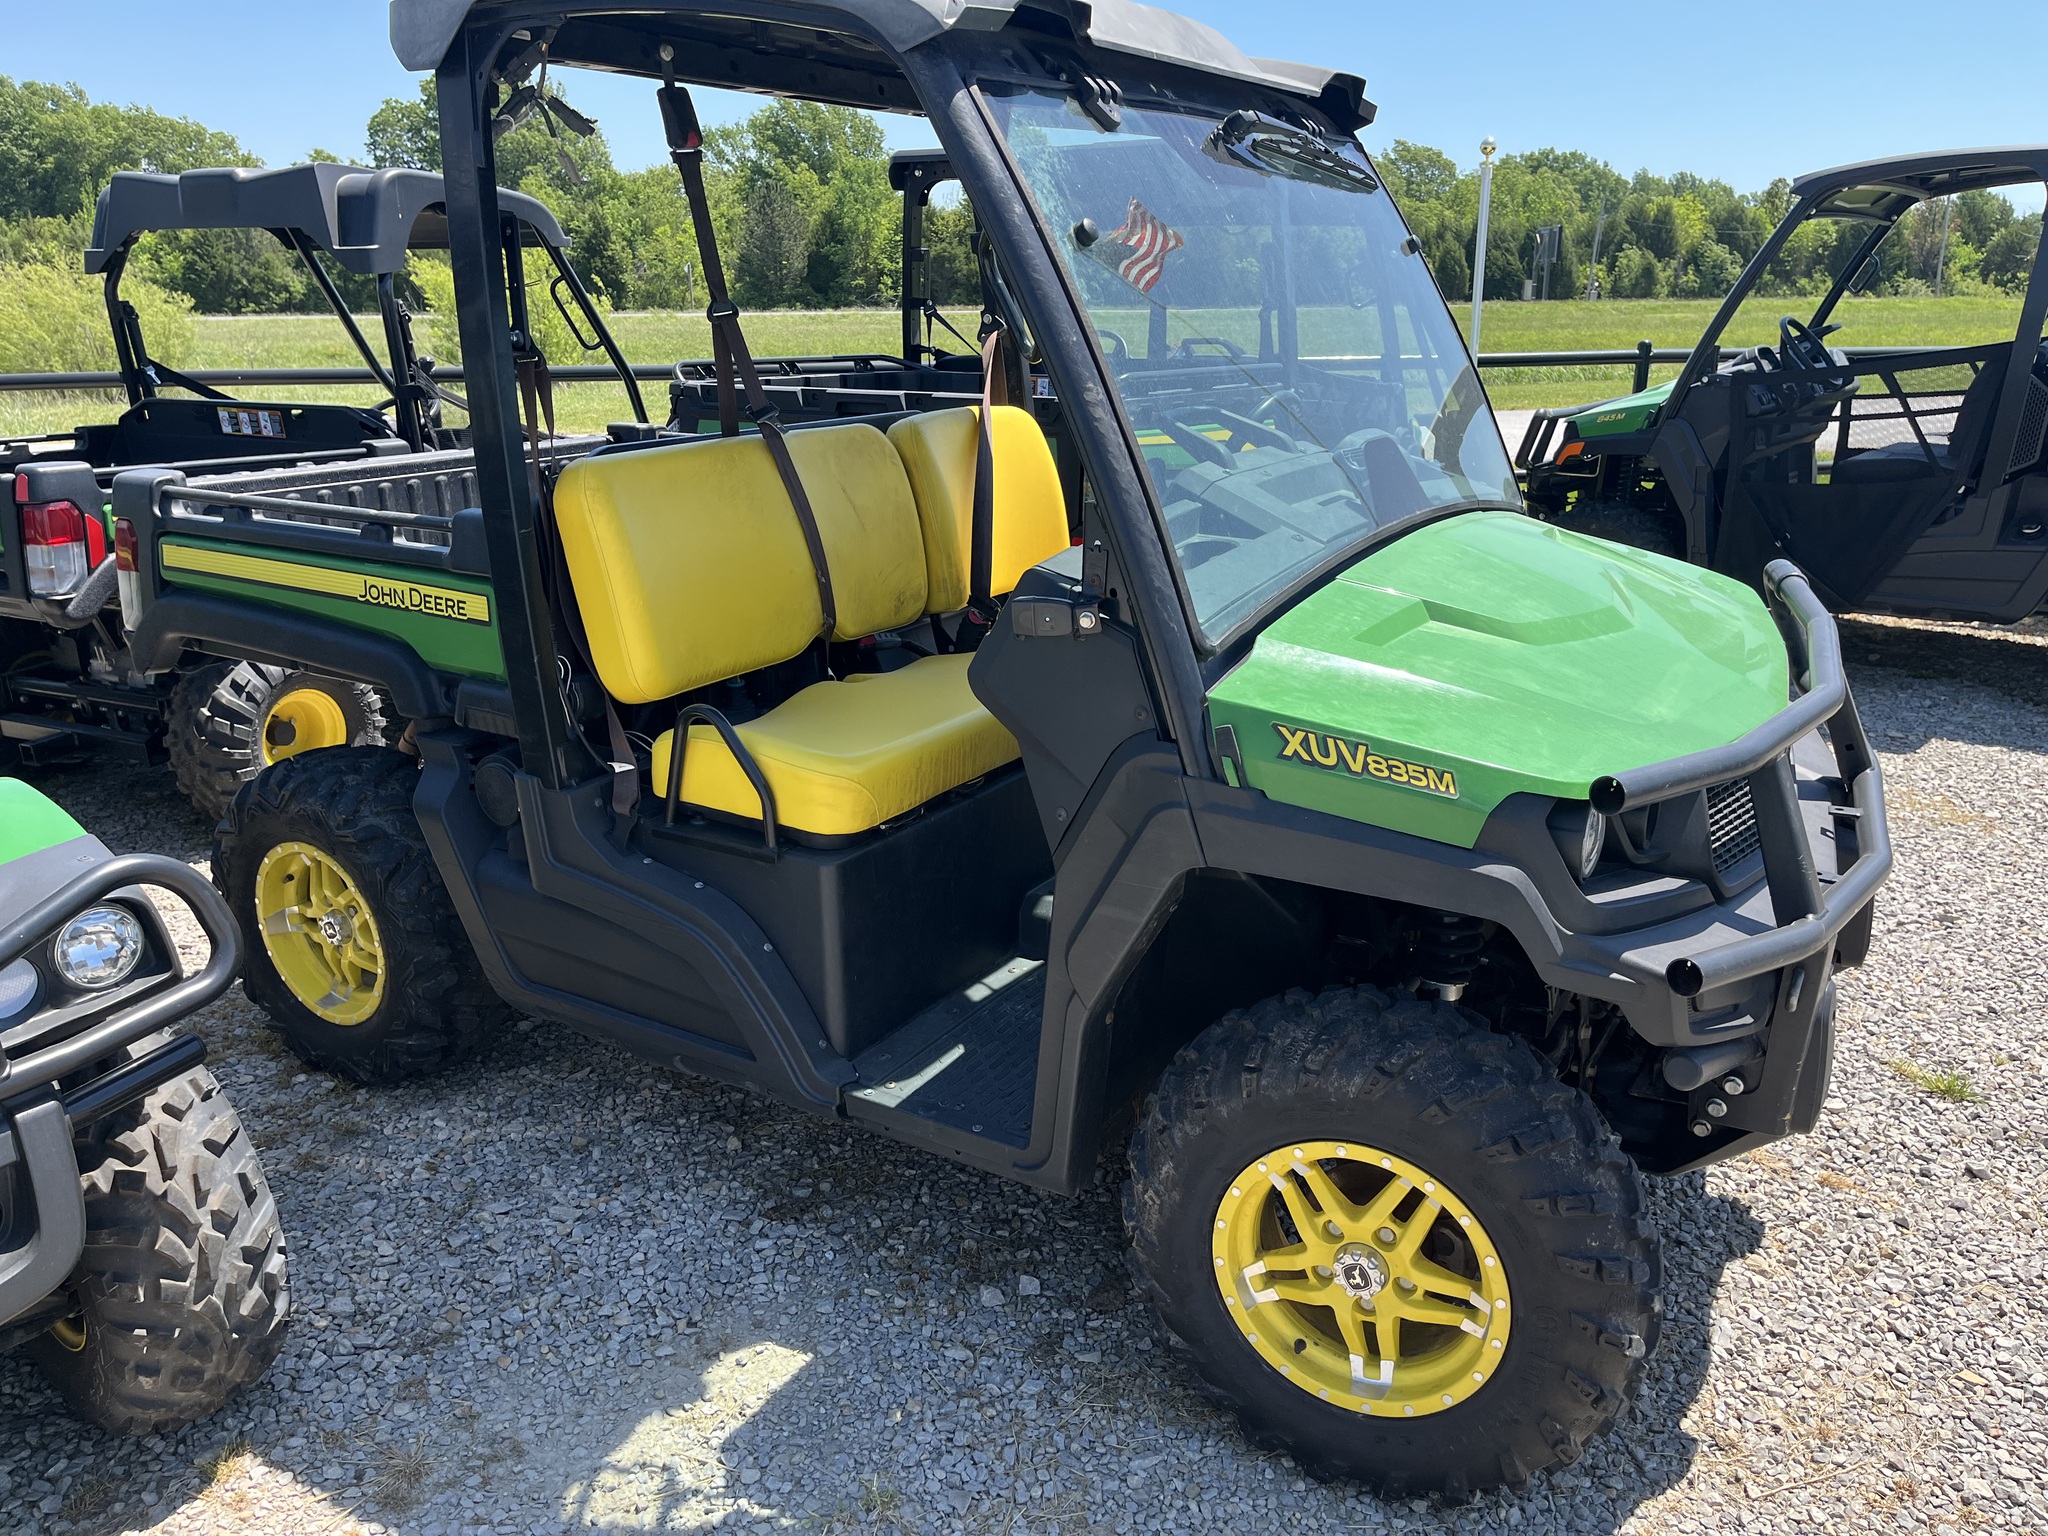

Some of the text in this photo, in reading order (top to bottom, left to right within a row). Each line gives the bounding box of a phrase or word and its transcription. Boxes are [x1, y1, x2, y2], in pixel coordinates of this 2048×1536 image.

[1596, 412, 1626, 423] 845M
[358, 579, 468, 618] JOHN DEERE
[1275, 724, 1457, 796] XUV835M
